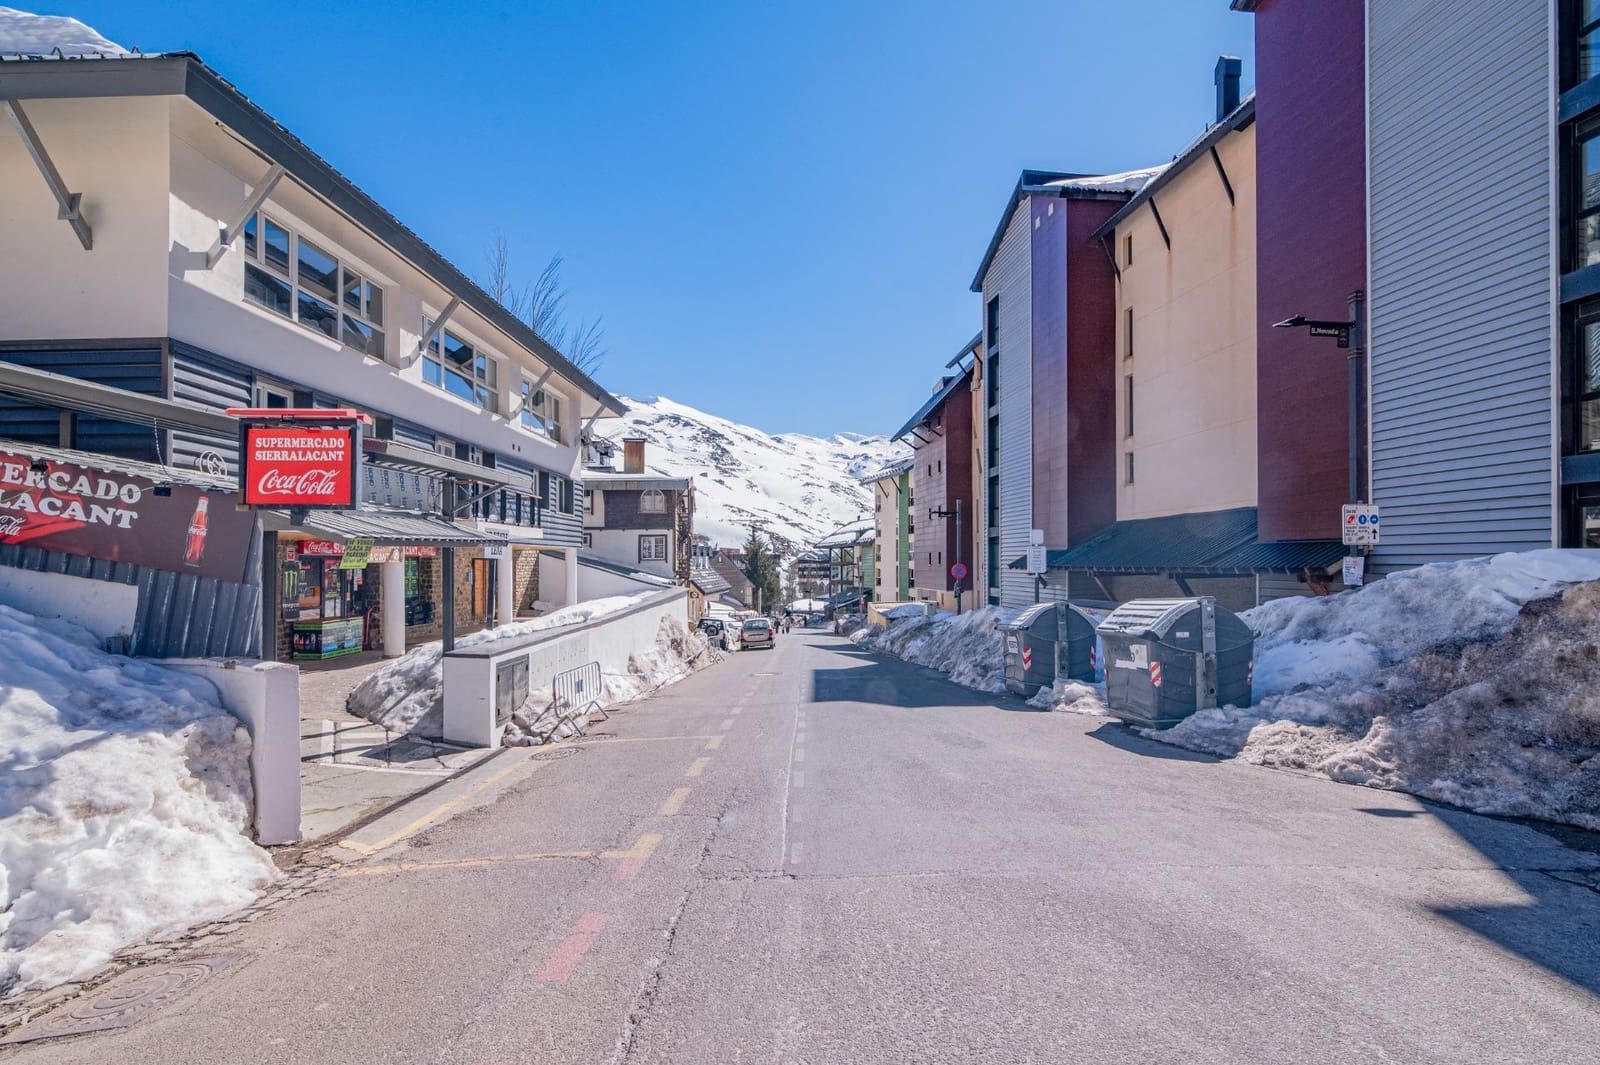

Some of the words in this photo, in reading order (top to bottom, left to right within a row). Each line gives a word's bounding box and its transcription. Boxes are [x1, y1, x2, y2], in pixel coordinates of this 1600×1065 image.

[255, 437, 345, 448] SUPERMERCADO
[255, 450, 345, 461] SIERRALACANT
[0, 461, 142, 504] ERCADO
